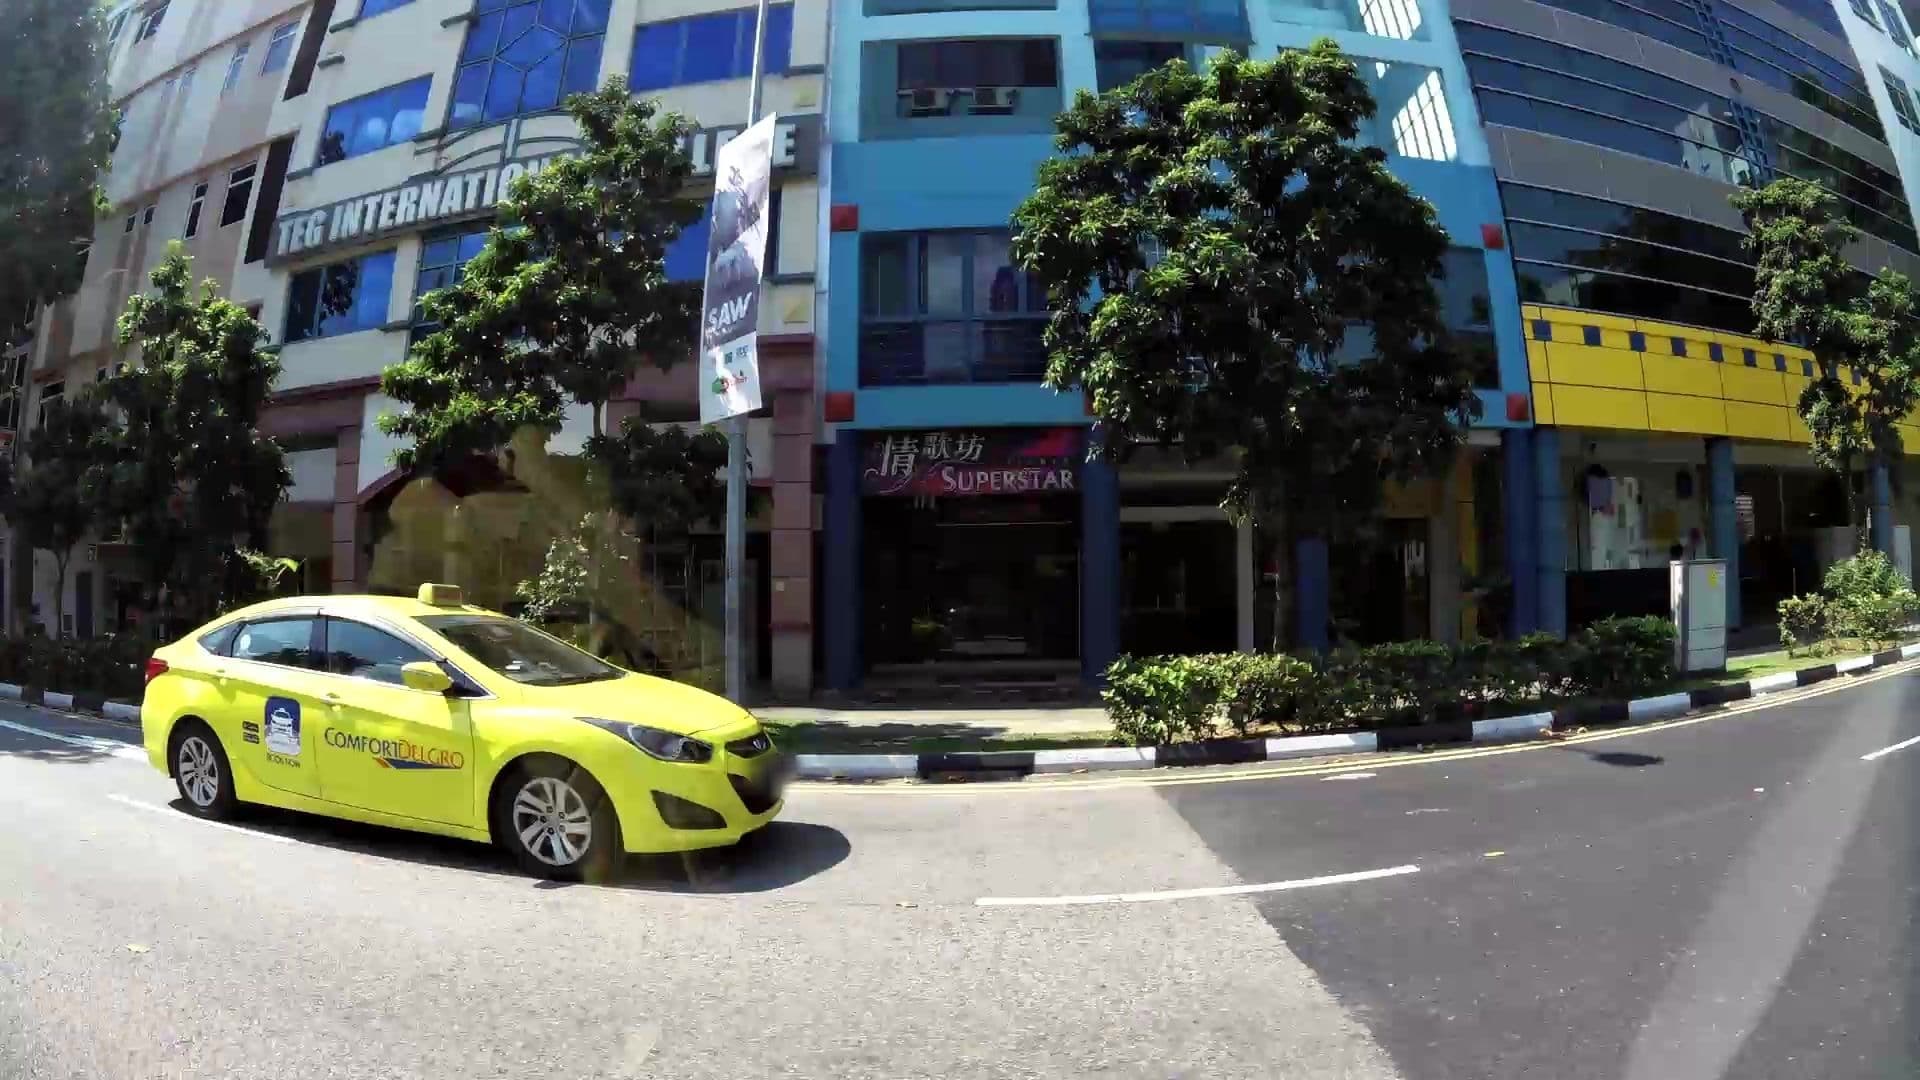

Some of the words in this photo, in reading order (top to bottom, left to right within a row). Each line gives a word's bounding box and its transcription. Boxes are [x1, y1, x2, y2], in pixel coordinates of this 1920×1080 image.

[278, 210, 328, 255] TEG
[708, 291, 752, 331] SAW
[880, 432, 986, 478] 情歌坊
[941, 466, 1074, 492] SUPERSTAR
